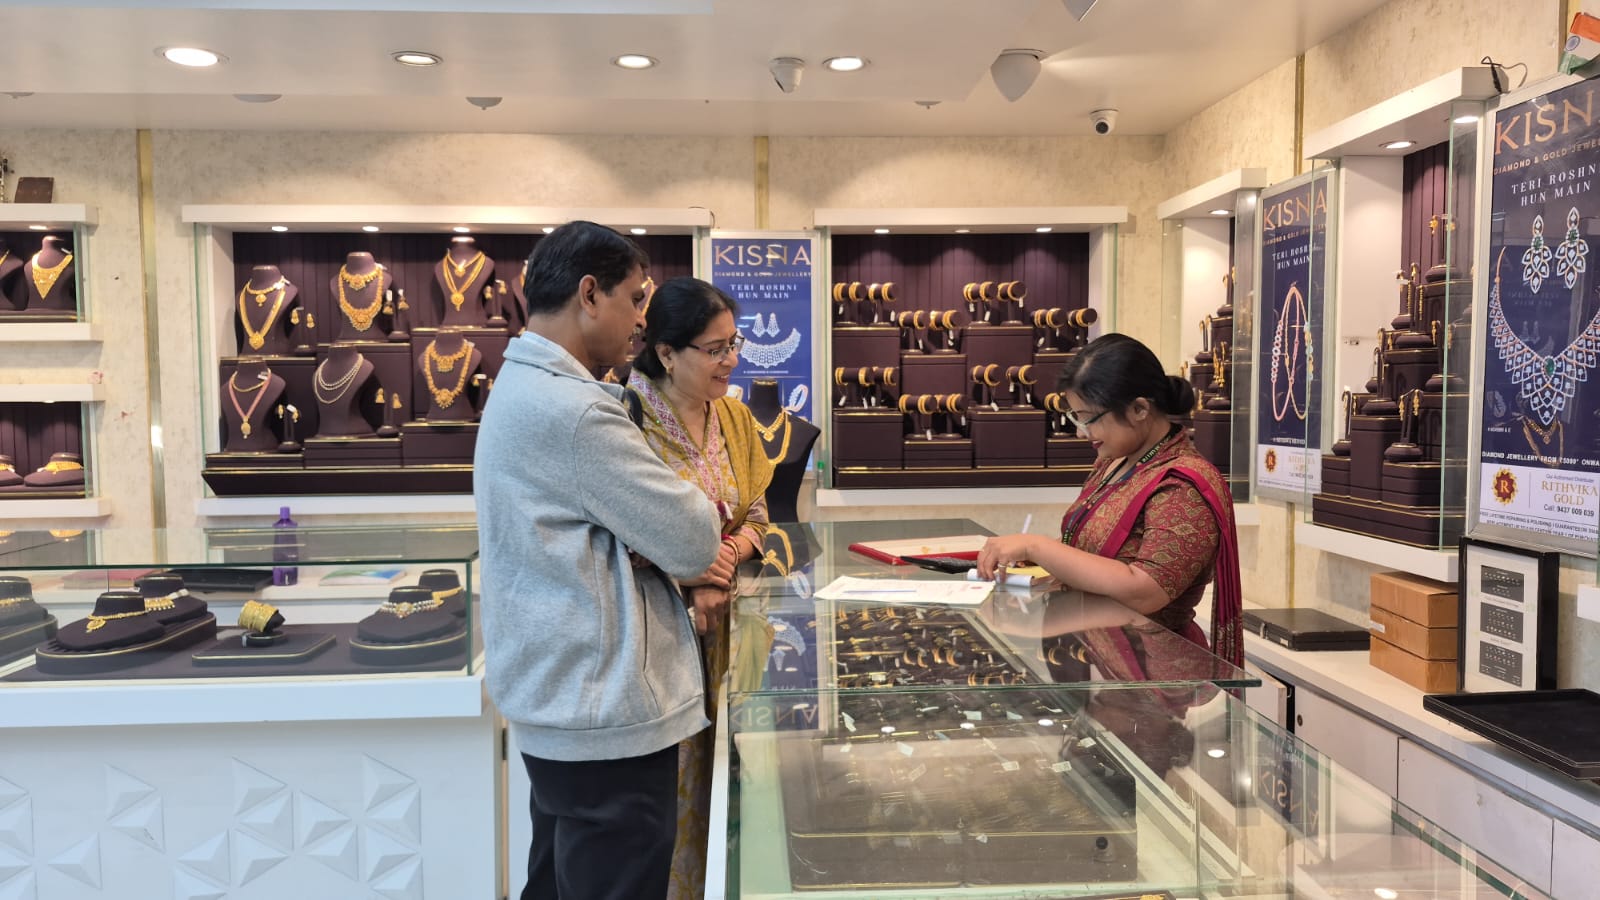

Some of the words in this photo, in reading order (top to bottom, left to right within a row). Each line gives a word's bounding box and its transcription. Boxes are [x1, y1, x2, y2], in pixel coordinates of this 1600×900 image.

[1493, 159, 1531, 175] DIAMOND
[1543, 148, 1567, 161] GOLD
[1511, 178, 1541, 194] TERI
[1521, 191, 1546, 206] HUN
[1554, 180, 1591, 199] MAIN
[1264, 188, 1327, 231] KISNA
[714, 245, 811, 267] KISNA
[1272, 249, 1288, 261] TERI
[1276, 260, 1290, 270] HUN
[1481, 451, 1505, 459] DIAMOND
[1506, 453, 1538, 462] JEWELLERY
[1540, 455, 1557, 463] FROM
[1500, 480, 1509, 493] R
[1542, 480, 1598, 496] RITHVIKA
[1554, 493, 1584, 505] GOLD
